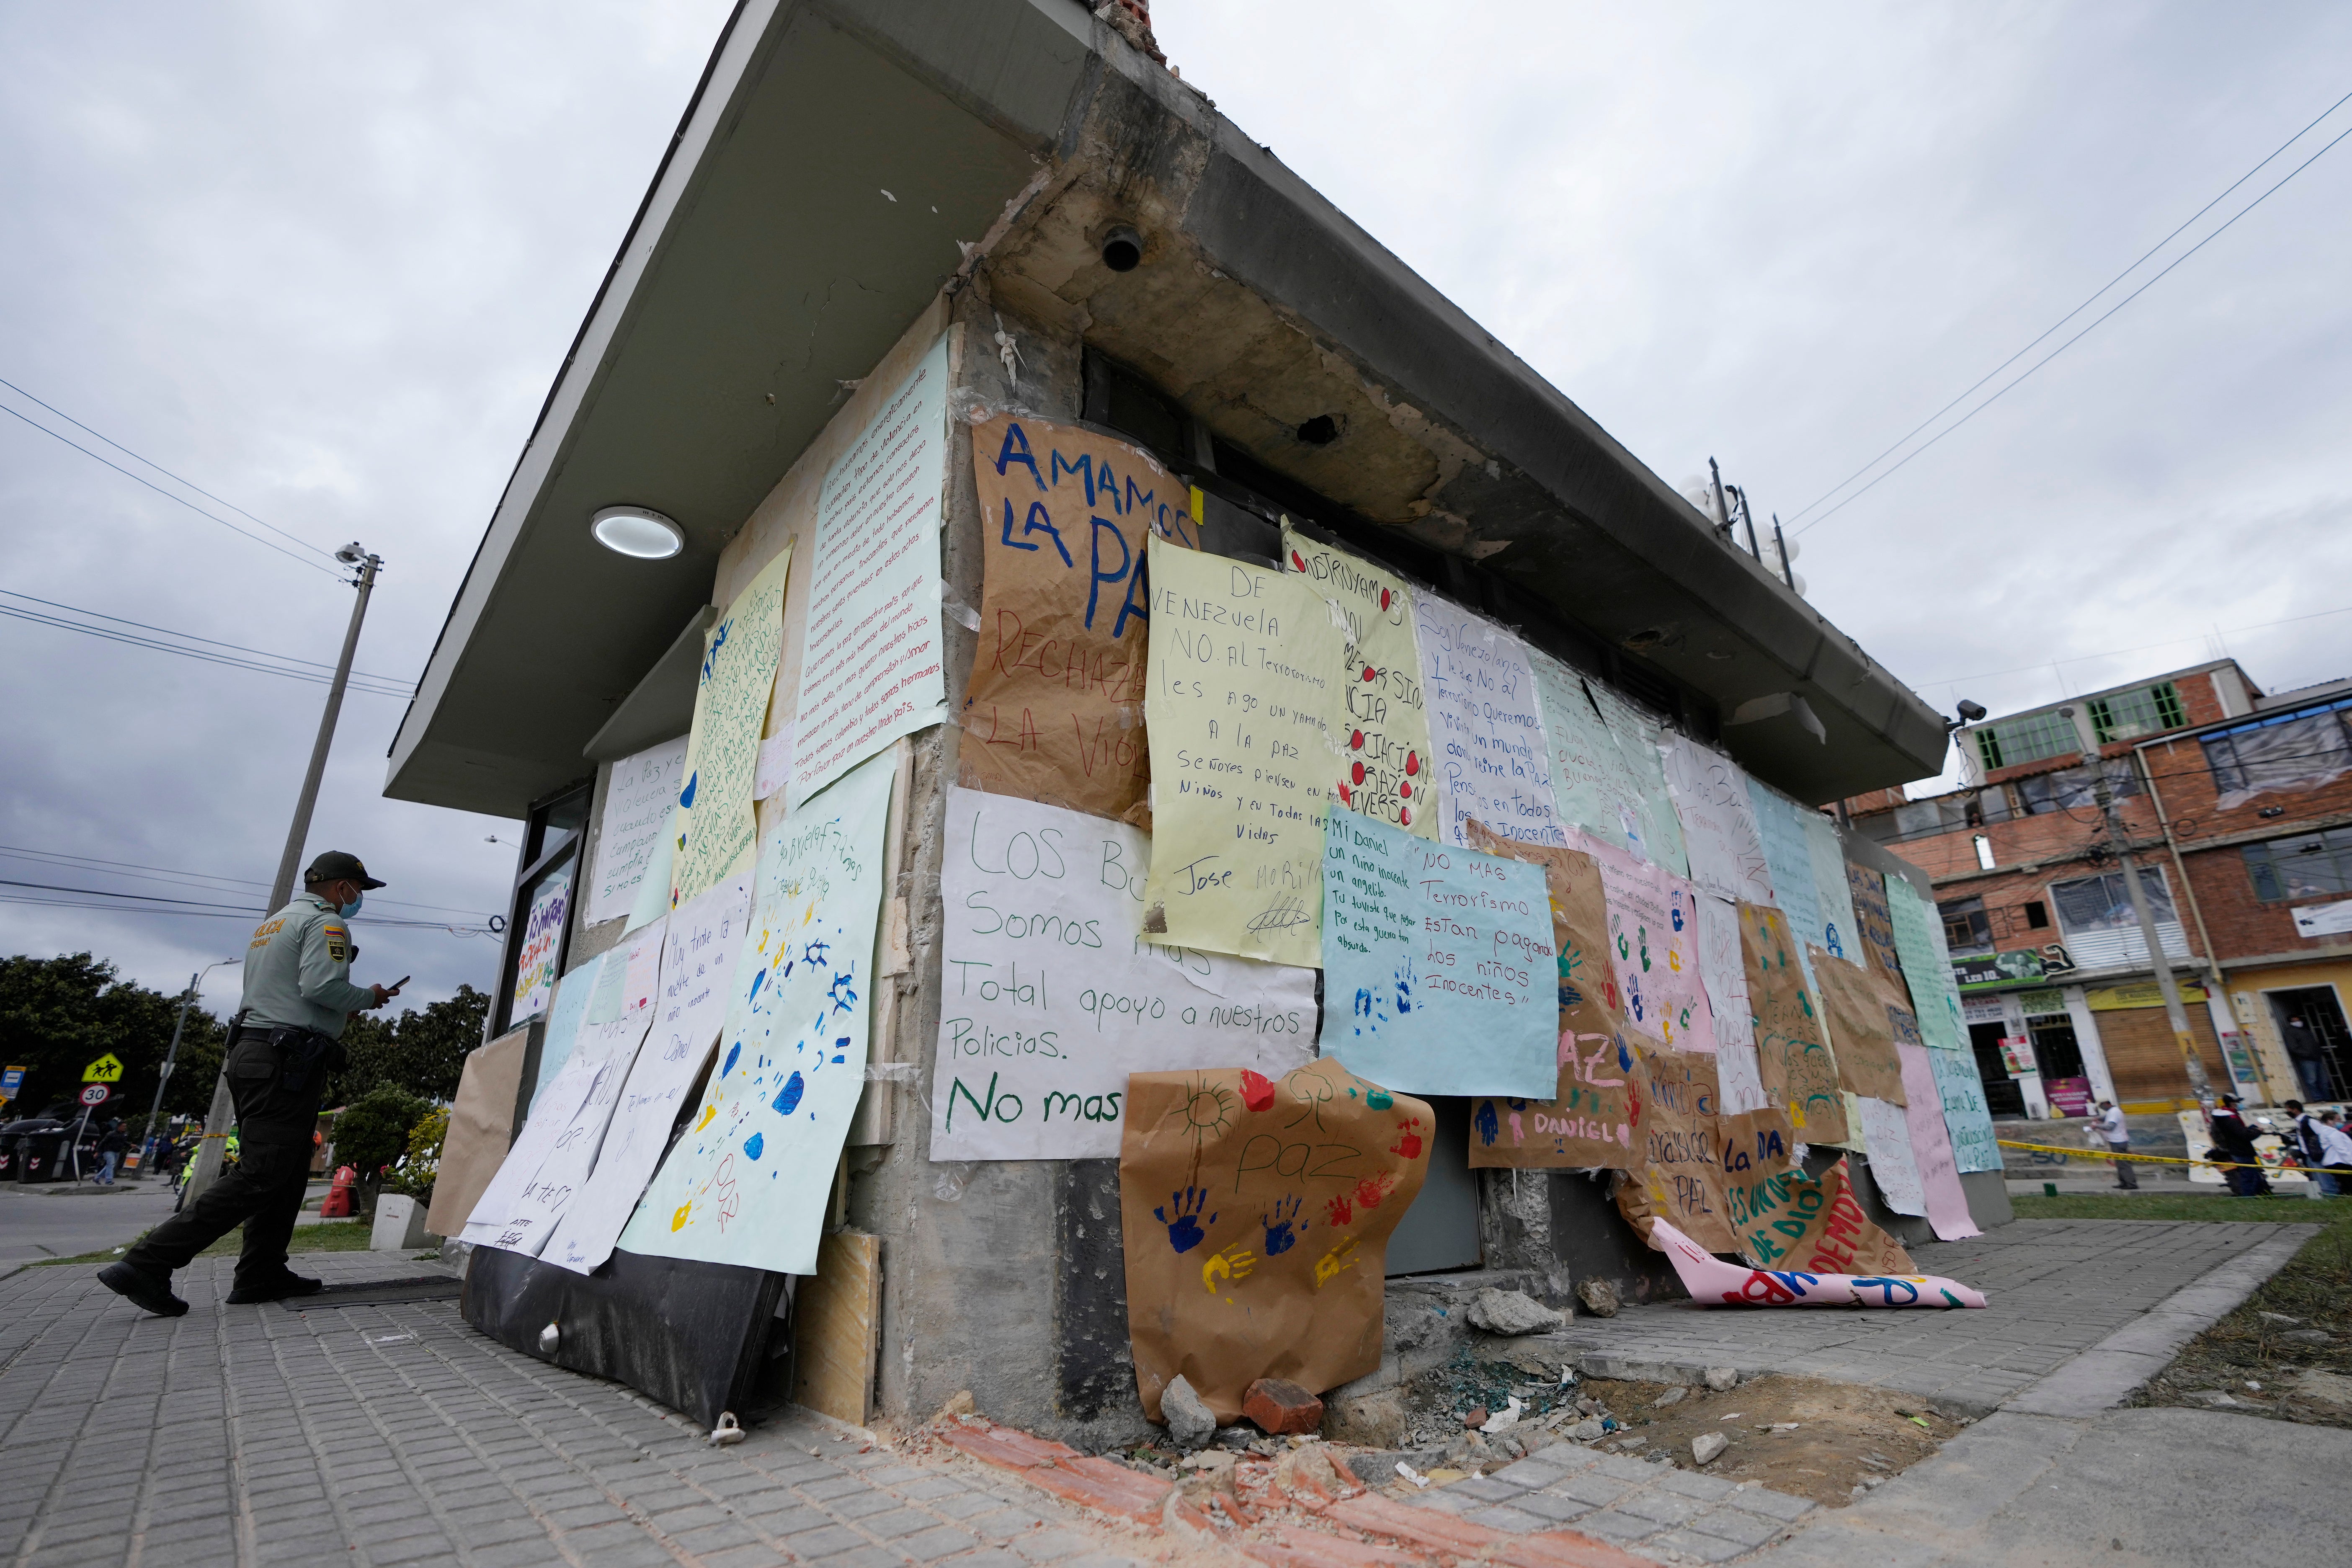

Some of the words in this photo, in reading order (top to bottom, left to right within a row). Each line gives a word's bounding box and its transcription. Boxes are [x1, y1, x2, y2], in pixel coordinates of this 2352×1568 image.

[827, 438, 868, 494] Rechazamos
[871, 369, 926, 438] energicamente
[825, 481, 851, 513] cualquier
[854, 462, 867, 480] tipo
[871, 451, 879, 462] de
[881, 413, 910, 451] violencia
[913, 401, 921, 414] en
[995, 423, 1194, 549] AMAMOS
[1001, 498, 1073, 567] LA
[1084, 515, 1149, 638] PA
[1231, 566, 1266, 598] DE
[1419, 603, 1452, 651] Soy
[800, 714, 807, 723] No
[836, 683, 843, 693] no
[845, 671, 856, 686] mas
[859, 653, 877, 678] guerra
[879, 630, 906, 657] nuestros
[908, 616, 928, 634] hijos
[992, 608, 1147, 704] RECHAZA
[1162, 660, 1202, 697] les
[1270, 705, 1285, 717] UN
[1393, 671, 1423, 711] SIN
[1477, 669, 1494, 691] No
[1501, 676, 1516, 701] al
[795, 752, 814, 769] Todos
[816, 738, 832, 753] somos
[835, 718, 858, 741] colombia
[859, 714, 863, 725] y
[865, 701, 879, 717] todos
[881, 683, 899, 704] somos
[901, 663, 940, 688] hermanos
[986, 706, 1045, 752] LA
[1484, 703, 1540, 734] Queremos
[1072, 713, 1148, 779] VIOL
[1210, 720, 1217, 739] A
[1271, 741, 1298, 759] PAZ
[1473, 734, 1486, 748] un
[1493, 735, 1532, 760] mundo
[1475, 756, 1506, 778] reine
[1512, 758, 1525, 778] la
[1237, 796, 1243, 810] Y
[1250, 801, 1262, 811] EN
[1494, 799, 1509, 812] en
[972, 811, 1065, 880] LOS
[1333, 818, 1348, 843] Mi
[1354, 830, 1388, 856] Daniel
[1173, 856, 1232, 895] Jose
[1329, 847, 1345, 859] un
[1378, 864, 1409, 889] inocente
[1330, 870, 1344, 882] un
[1352, 877, 1386, 898] angelito.
[1469, 862, 1506, 880] MAS
[1333, 890, 1345, 904] Tu
[1352, 896, 1380, 913] tuviste
[1384, 906, 1396, 923] que
[1401, 914, 1416, 926] pagar
[1419, 880, 1529, 915] Terrorismo
[966, 890, 1102, 948] Somos
[1335, 910, 1347, 926] Por
[1354, 918, 1369, 932] esta
[1374, 926, 1395, 941] guerra
[1399, 929, 1409, 944] tan
[666, 932, 684, 984] Muy
[691, 926, 711, 953] triste
[720, 916, 728, 939] la
[1338, 934, 1370, 953] absurda.
[1494, 929, 1554, 962] pagando
[667, 974, 689, 998] muerte
[697, 963, 705, 977] de
[715, 953, 722, 965] un
[1477, 961, 1529, 987] niños
[668, 1007, 680, 1022] niño
[689, 987, 710, 1008] inocente
[949, 960, 1047, 1011] Total
[1079, 988, 1165, 1032] apoyo
[1181, 1007, 1197, 1026] a
[1210, 1006, 1300, 1034] nuestros
[664, 1031, 694, 1061] Daniel
[946, 1017, 1068, 1061] Policias.
[1558, 1029, 1625, 1087] AZ
[85, 1089, 104, 1100] 30
[946, 1071, 1023, 1134] No
[1043, 1091, 1122, 1123] mas
[1533, 1107, 1614, 1143] DANIEL
[1725, 1138, 1751, 1173] La
[1729, 1186, 1749, 1226] ES
[1748, 1230, 1786, 1264] DE
